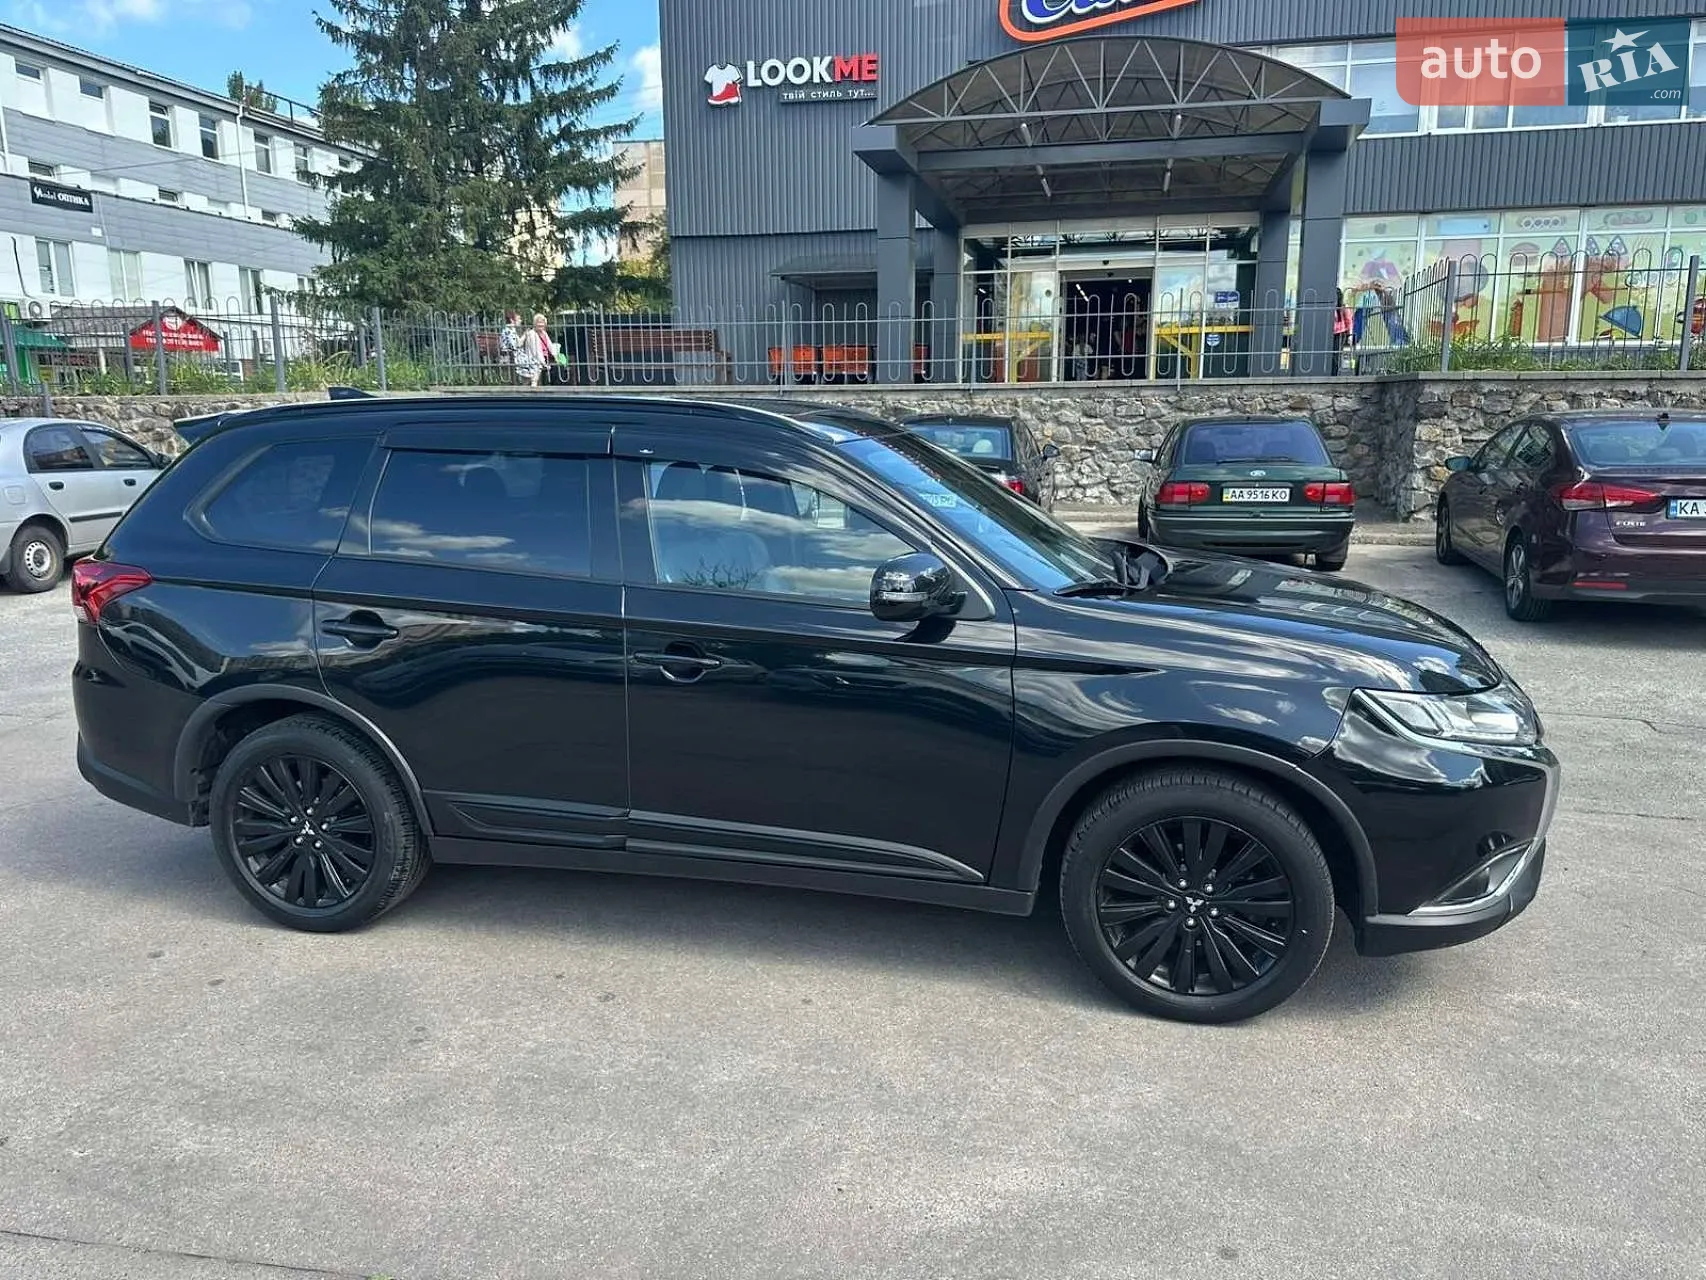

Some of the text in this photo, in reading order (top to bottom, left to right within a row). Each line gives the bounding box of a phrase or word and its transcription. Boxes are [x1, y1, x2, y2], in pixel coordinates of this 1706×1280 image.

[746, 53, 878, 88] LOOKME
[783, 89, 806, 100] твій
[810, 89, 843, 99] стиль
